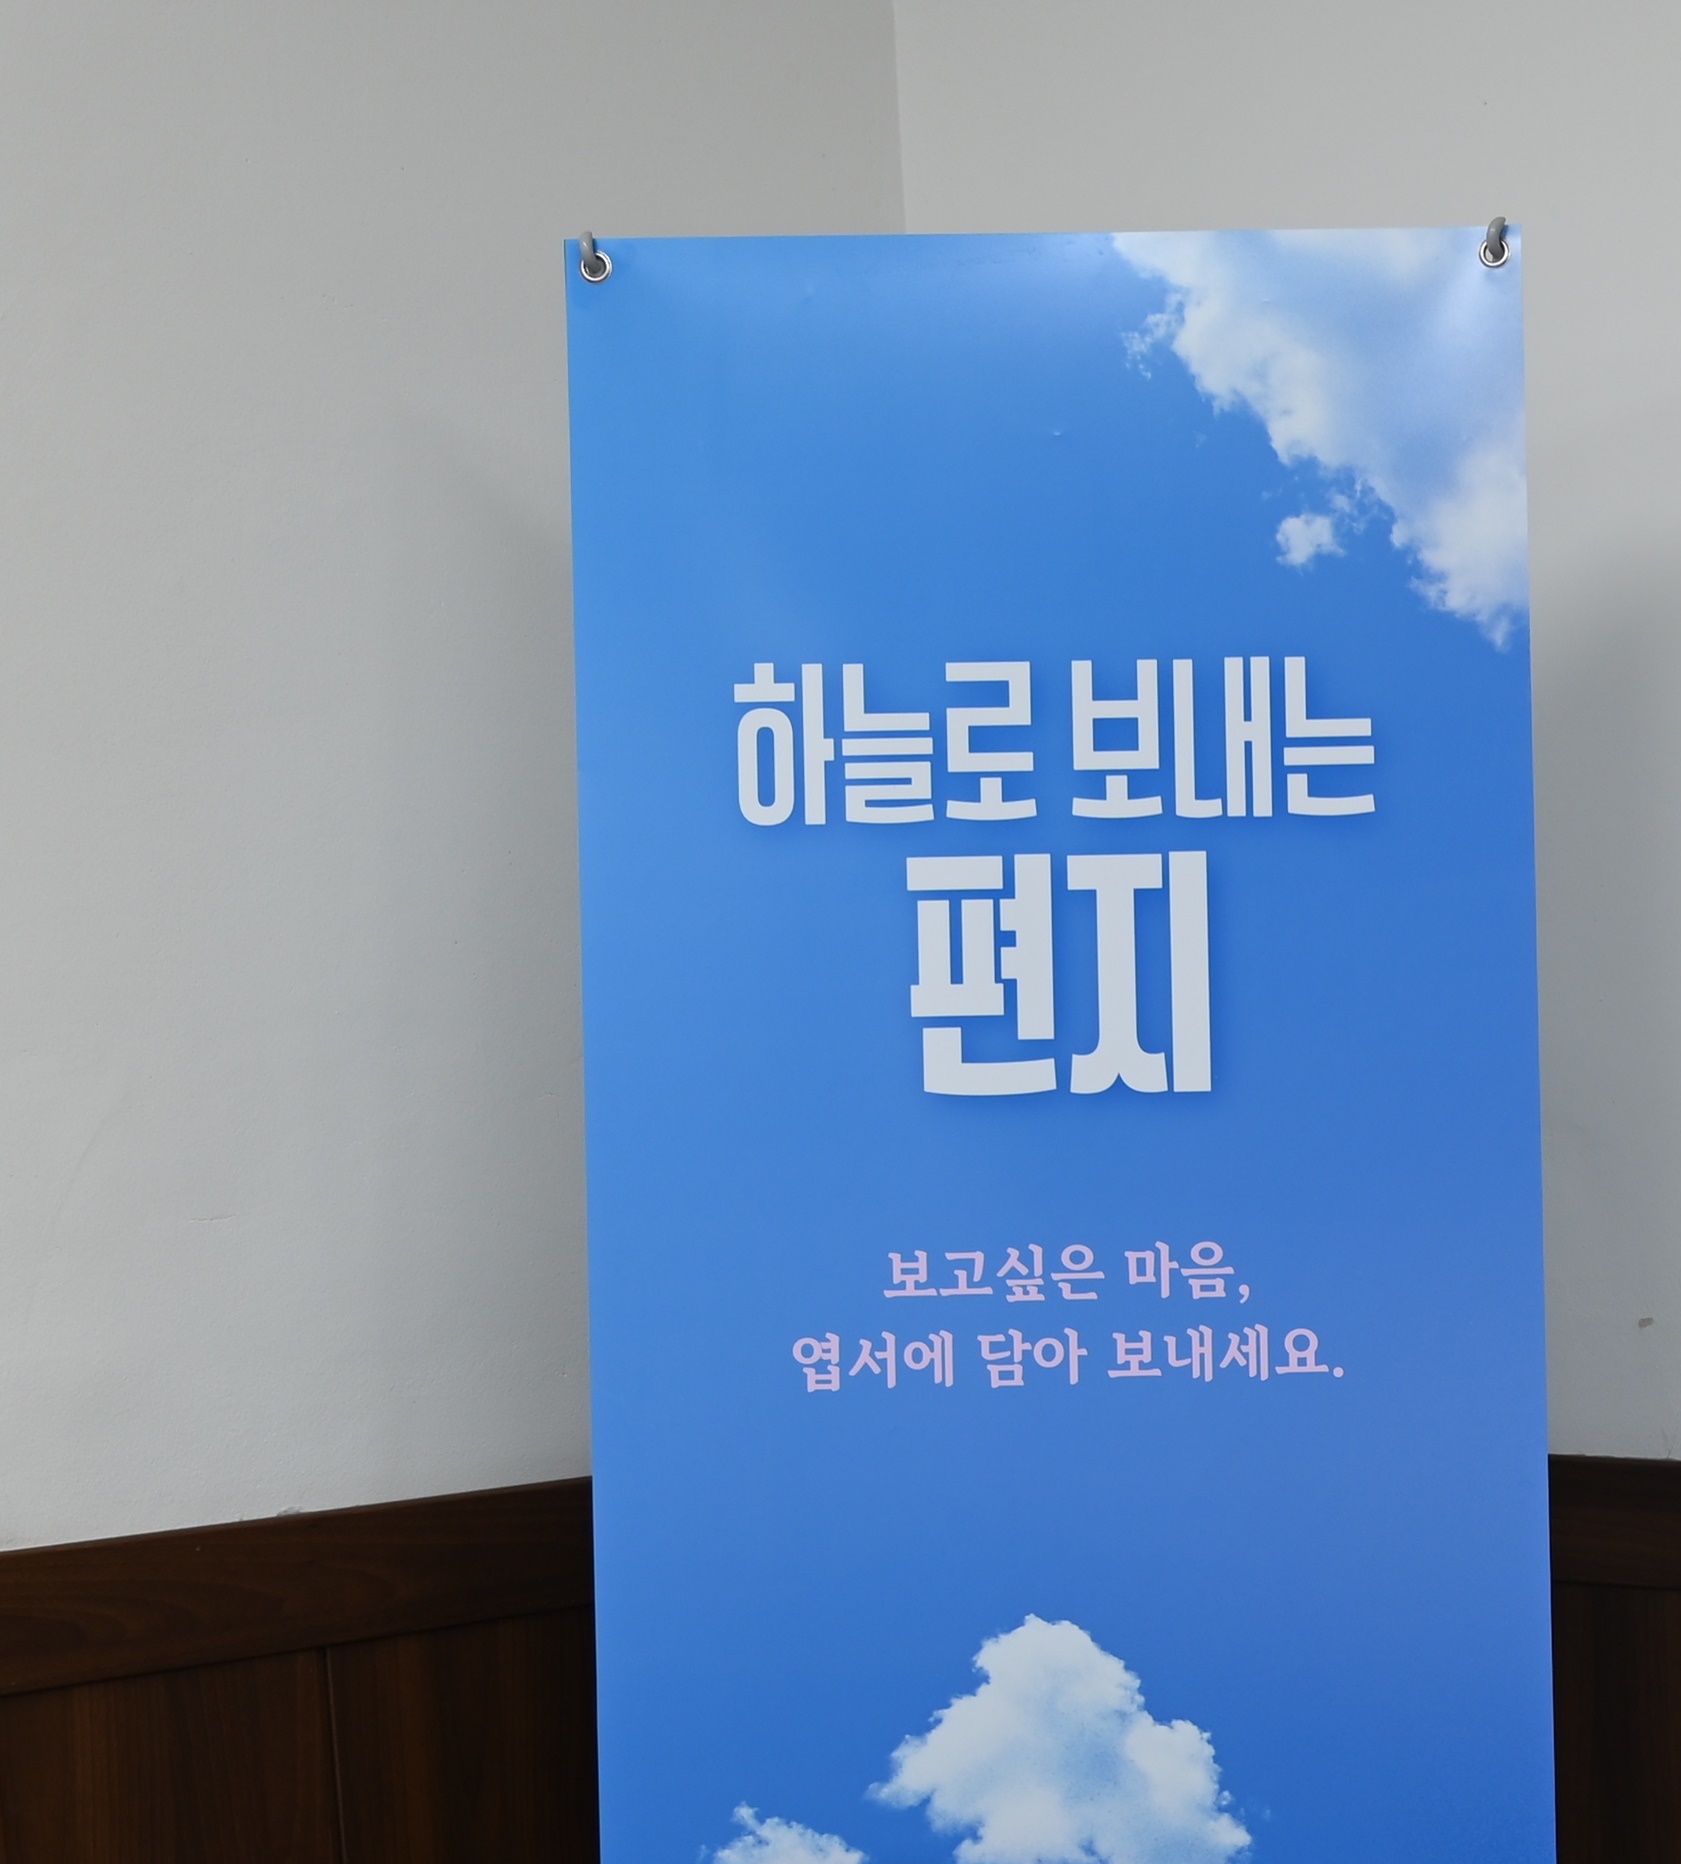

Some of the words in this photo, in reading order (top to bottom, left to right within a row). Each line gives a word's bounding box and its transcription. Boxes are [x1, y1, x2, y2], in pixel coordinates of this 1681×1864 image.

[732, 660, 1038, 827] 하늘로
[1070, 655, 1376, 820] 보내는
[905, 849, 1213, 1097] 편지
[882, 1242, 1106, 1303] 보고싶은
[1123, 1240, 1251, 1305] 마음,
[791, 1329, 955, 1394] 엽서에
[976, 1326, 1088, 1390] 담아
[1107, 1322, 1345, 1383] 보내세요.
